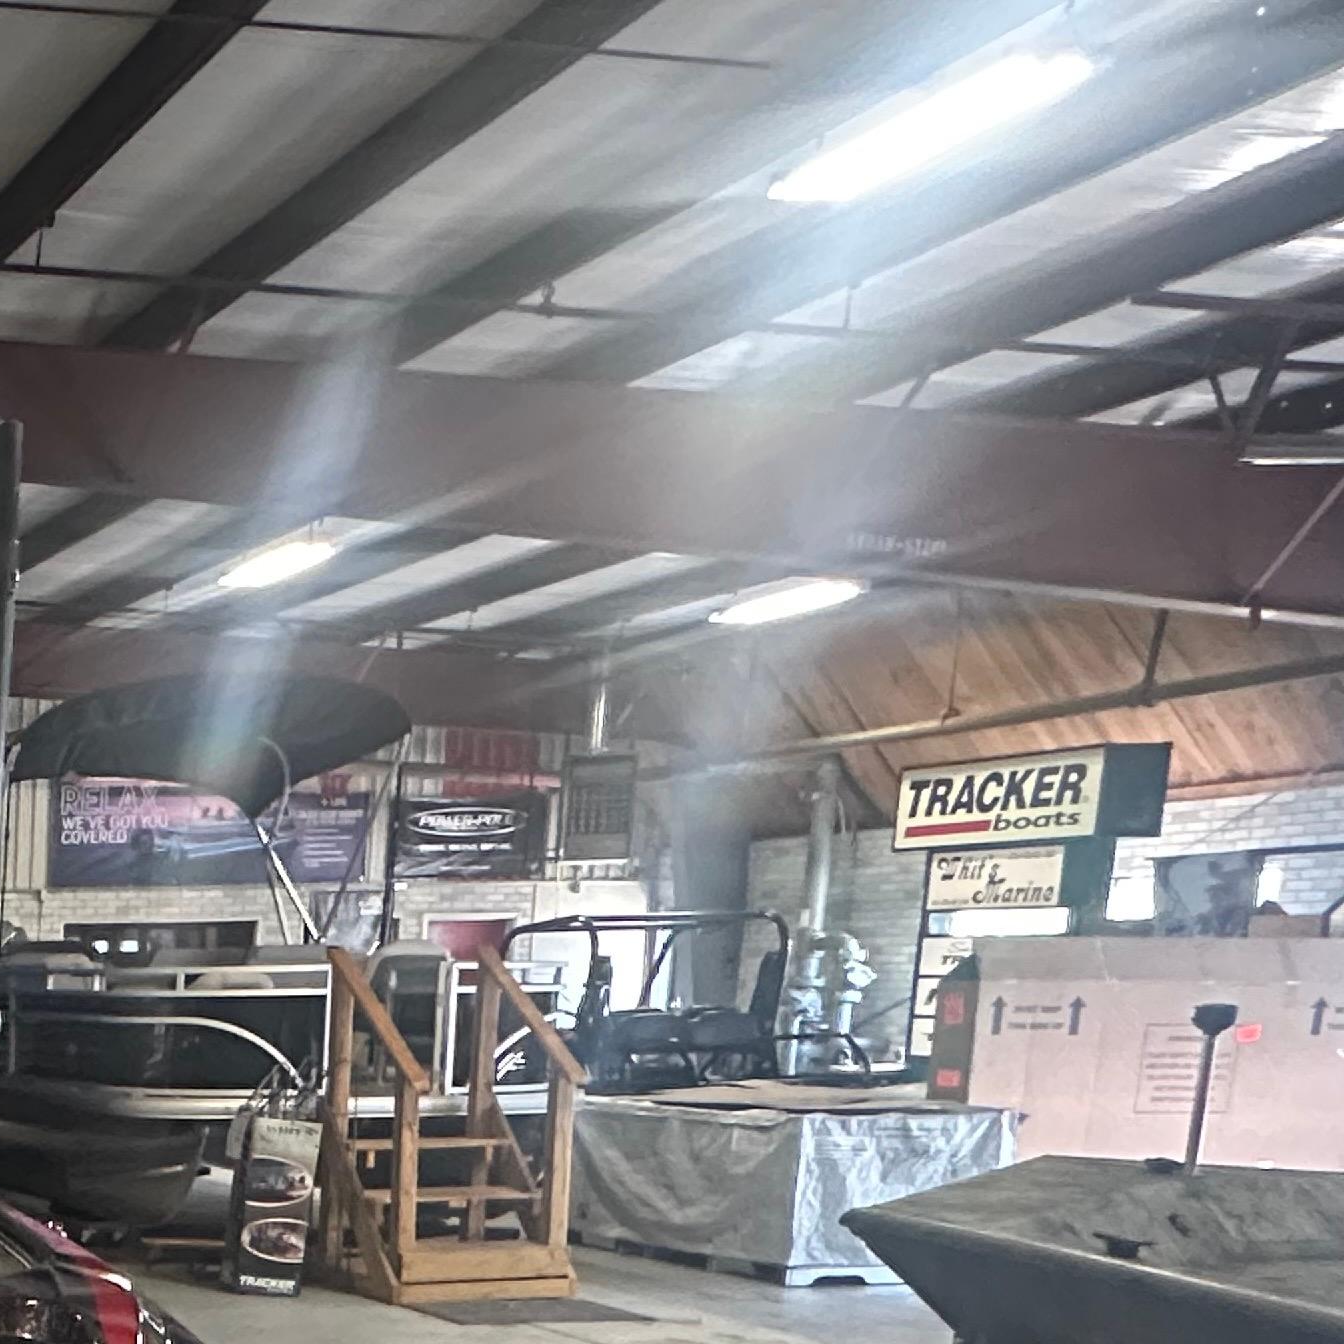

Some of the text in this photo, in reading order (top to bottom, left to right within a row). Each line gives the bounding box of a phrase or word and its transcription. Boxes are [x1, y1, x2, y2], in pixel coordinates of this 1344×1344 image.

[61, 783, 158, 816] RELAX
[908, 763, 1088, 818] TRACKER
[992, 812, 1081, 832] boats
